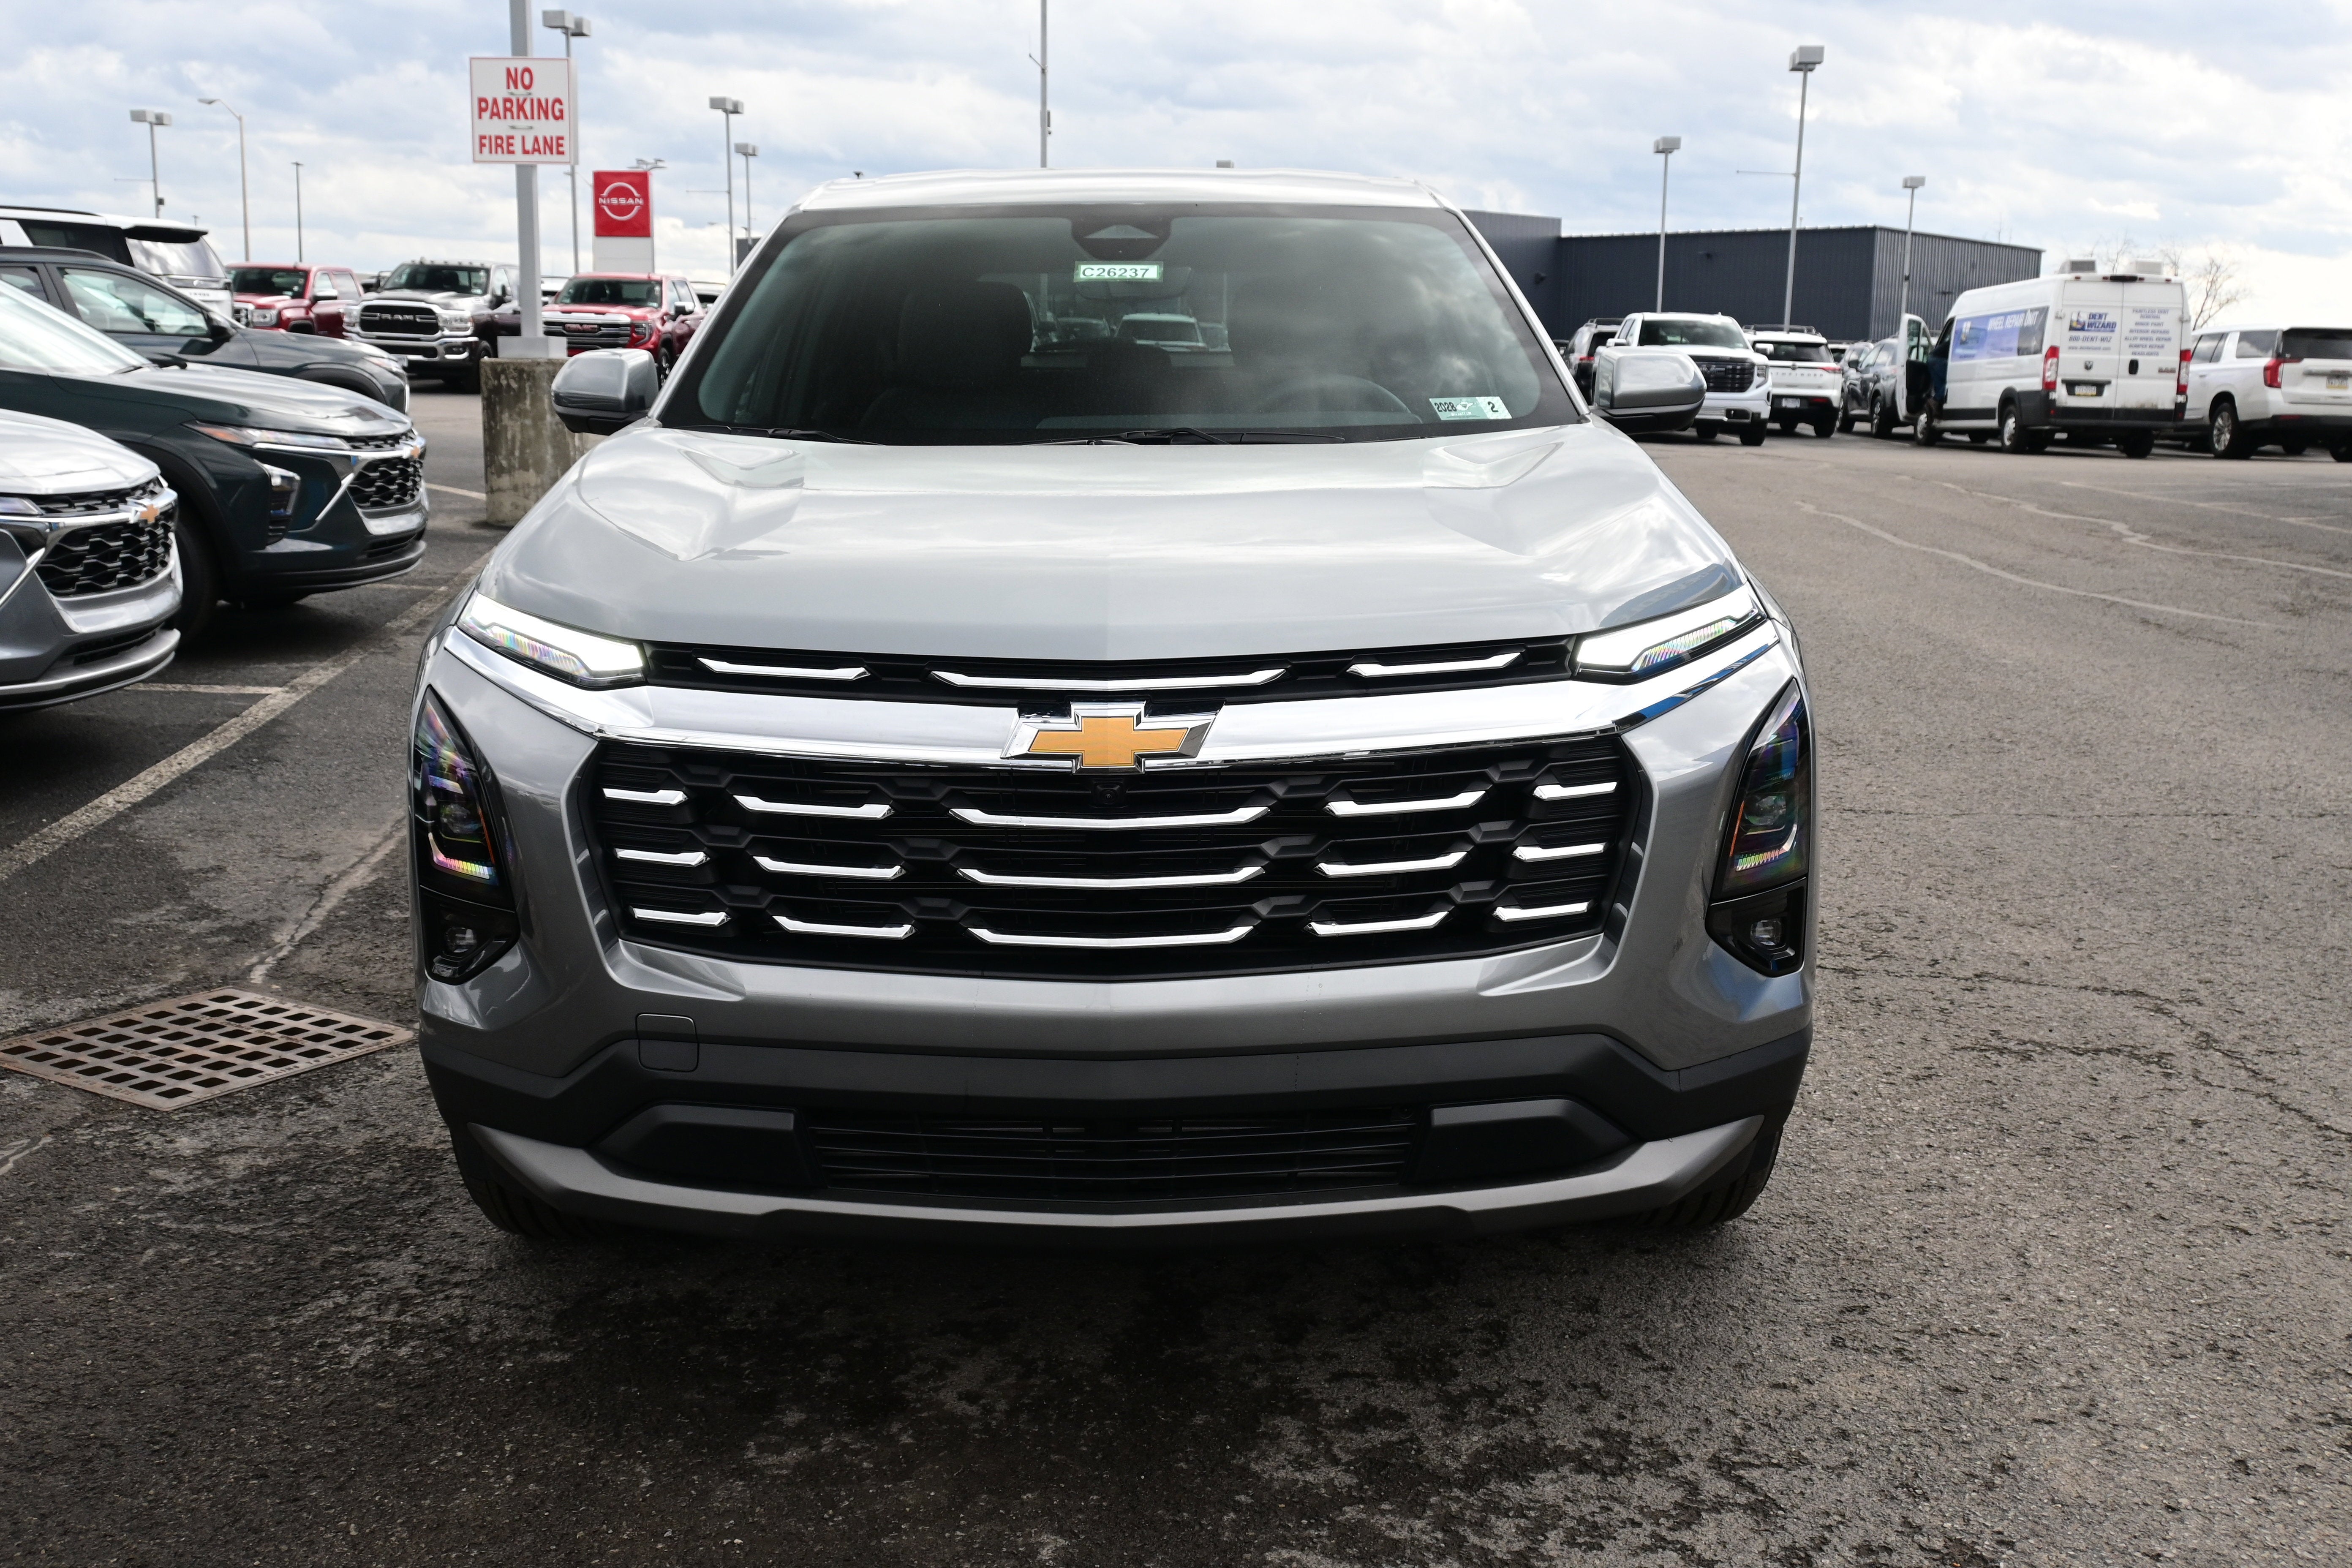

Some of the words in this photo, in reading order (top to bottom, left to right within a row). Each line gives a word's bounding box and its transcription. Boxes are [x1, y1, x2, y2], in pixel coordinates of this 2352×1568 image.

[506, 67, 533, 90] NO
[477, 97, 564, 120] PARKING
[479, 134, 515, 154] FIRE
[521, 135, 565, 155] LANE
[1082, 267, 1149, 278] C26237
[2005, 313, 2025, 328] REPAIR
[1435, 402, 1457, 412] 2028
[1488, 402, 1499, 413] 2
[258, 1065, 300, 1079] DRAINS
